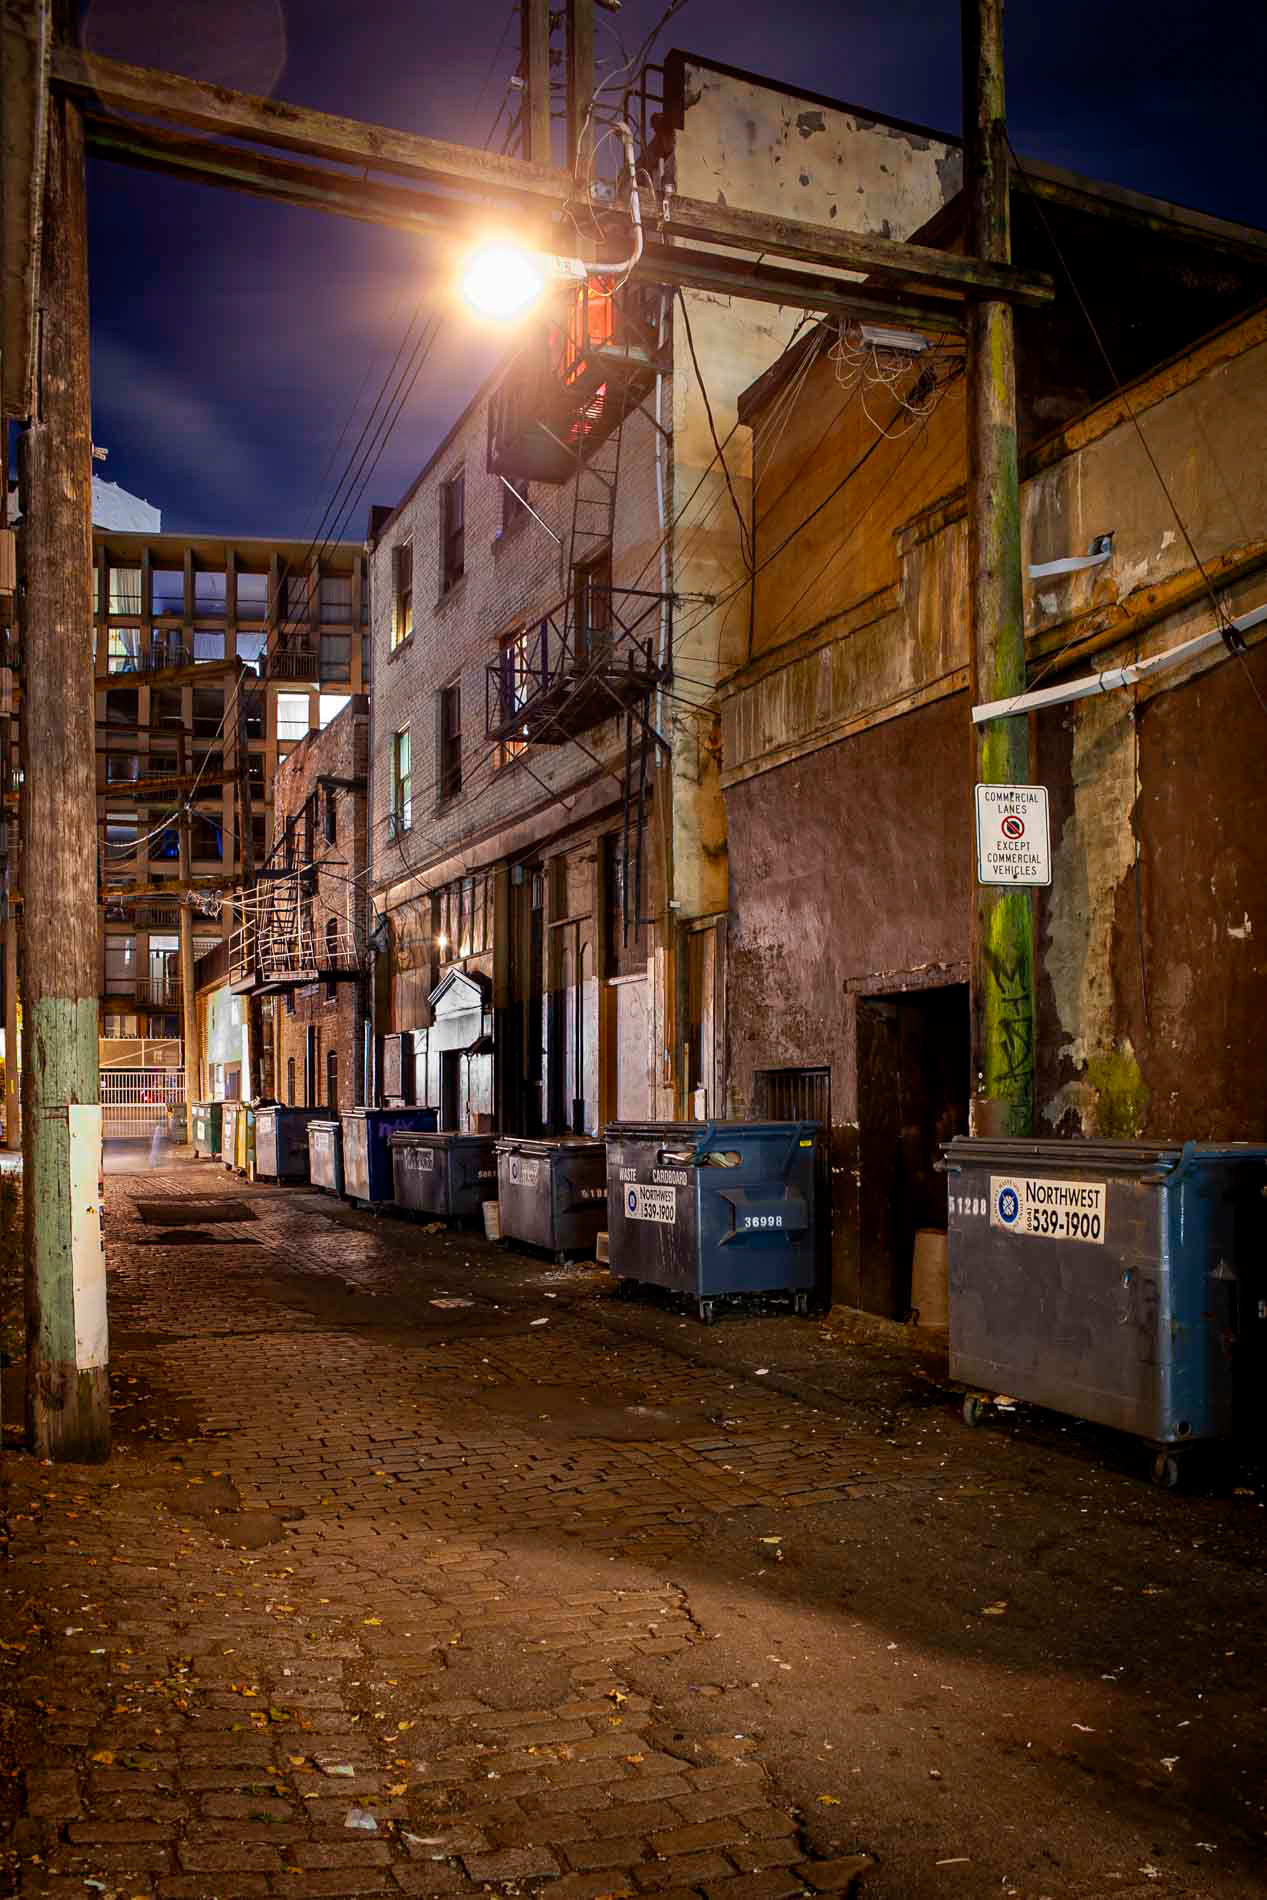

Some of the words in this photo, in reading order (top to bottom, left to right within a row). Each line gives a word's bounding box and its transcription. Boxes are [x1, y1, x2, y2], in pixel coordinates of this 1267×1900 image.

[985, 792, 1038, 803] COMMERCIAL
[998, 805, 1027, 814] LANES
[997, 841, 1030, 851] EXCEPT
[987, 853, 1041, 864] COMMERCIAL
[993, 865, 1037, 876] VEHICLES
[620, 1168, 637, 1181] WASTE
[652, 1169, 688, 1186] CARDBOARD
[640, 1187, 674, 1202] NORTHWEST
[1026, 1181, 1100, 1209] NORTHWEST
[644, 1203, 674, 1221] 539-1900
[744, 1216, 783, 1228] 36998
[1033, 1208, 1101, 1239] 539-1900
